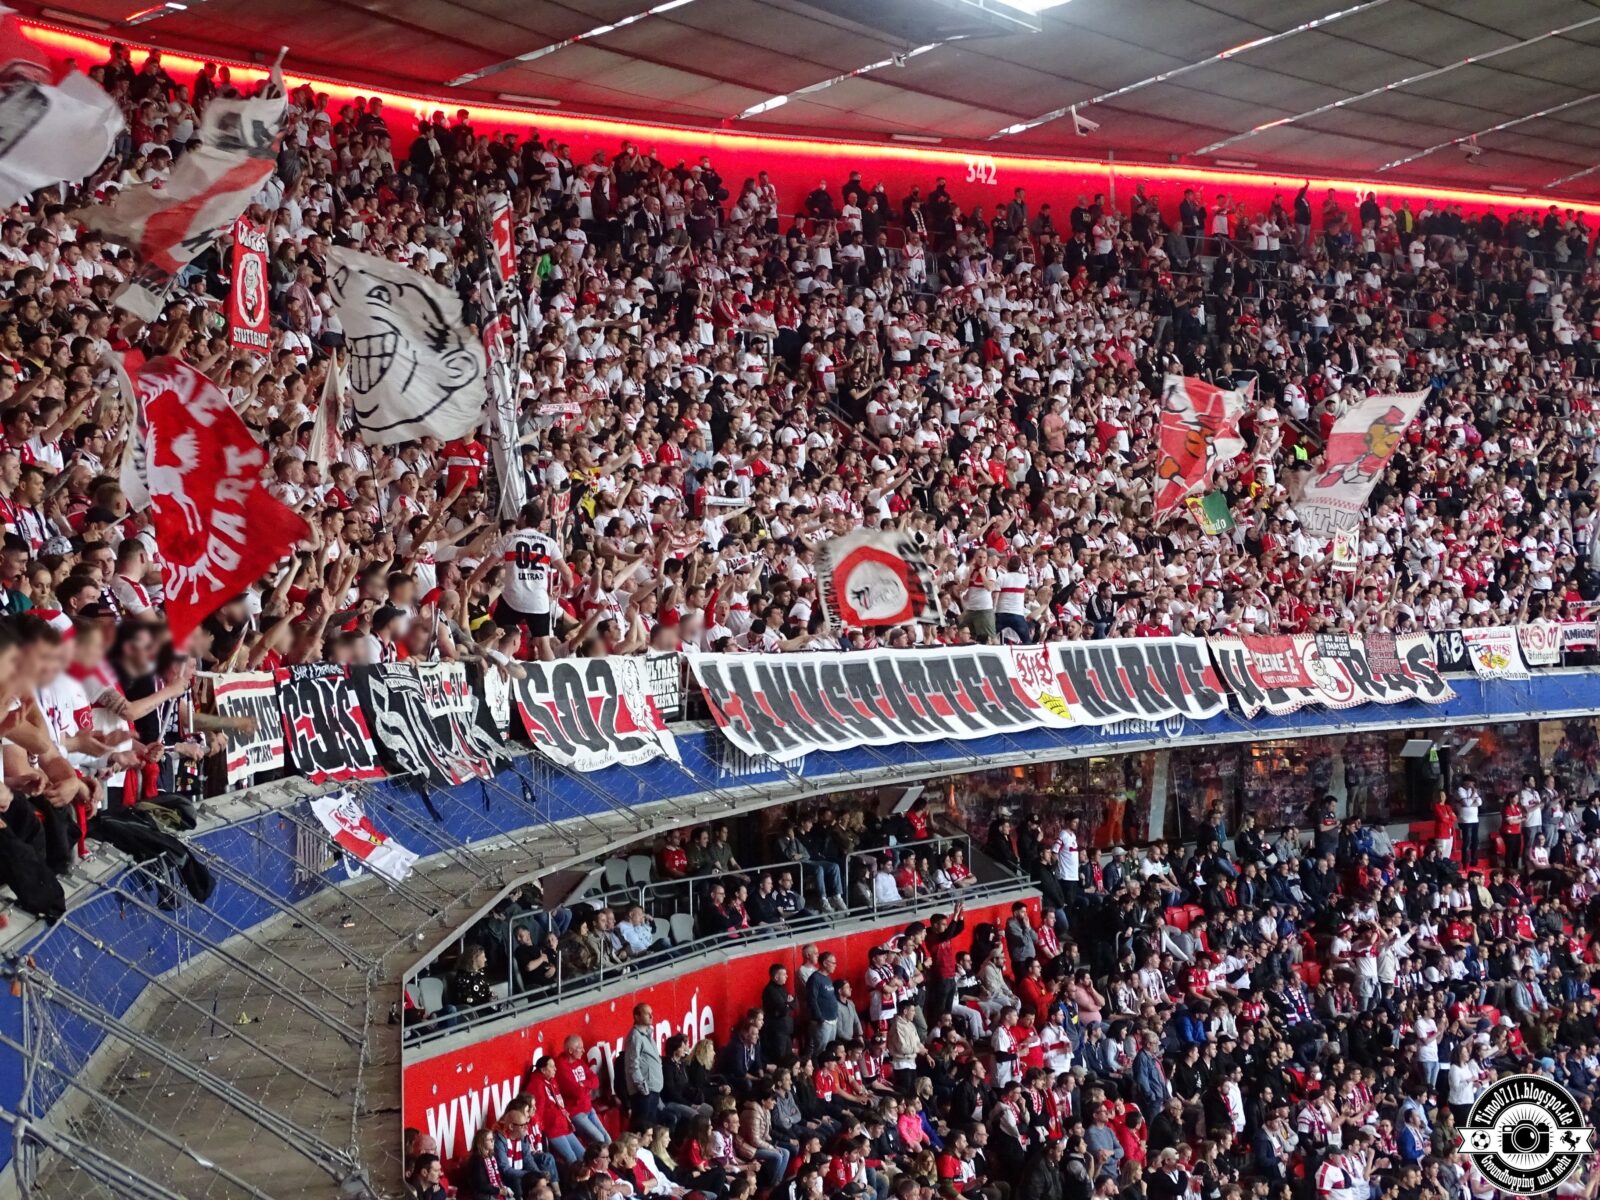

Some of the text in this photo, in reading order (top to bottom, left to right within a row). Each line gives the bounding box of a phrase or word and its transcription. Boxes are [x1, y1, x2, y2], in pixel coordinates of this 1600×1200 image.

[966, 156, 998, 185] 342
[516, 541, 546, 571] 02
[518, 572, 544, 581] ULTRAS
[1325, 642, 1349, 651] IMMER
[1285, 648, 1300, 675] E
[1059, 643, 1224, 719] KURVE
[699, 652, 1047, 753] CANNSTATTER
